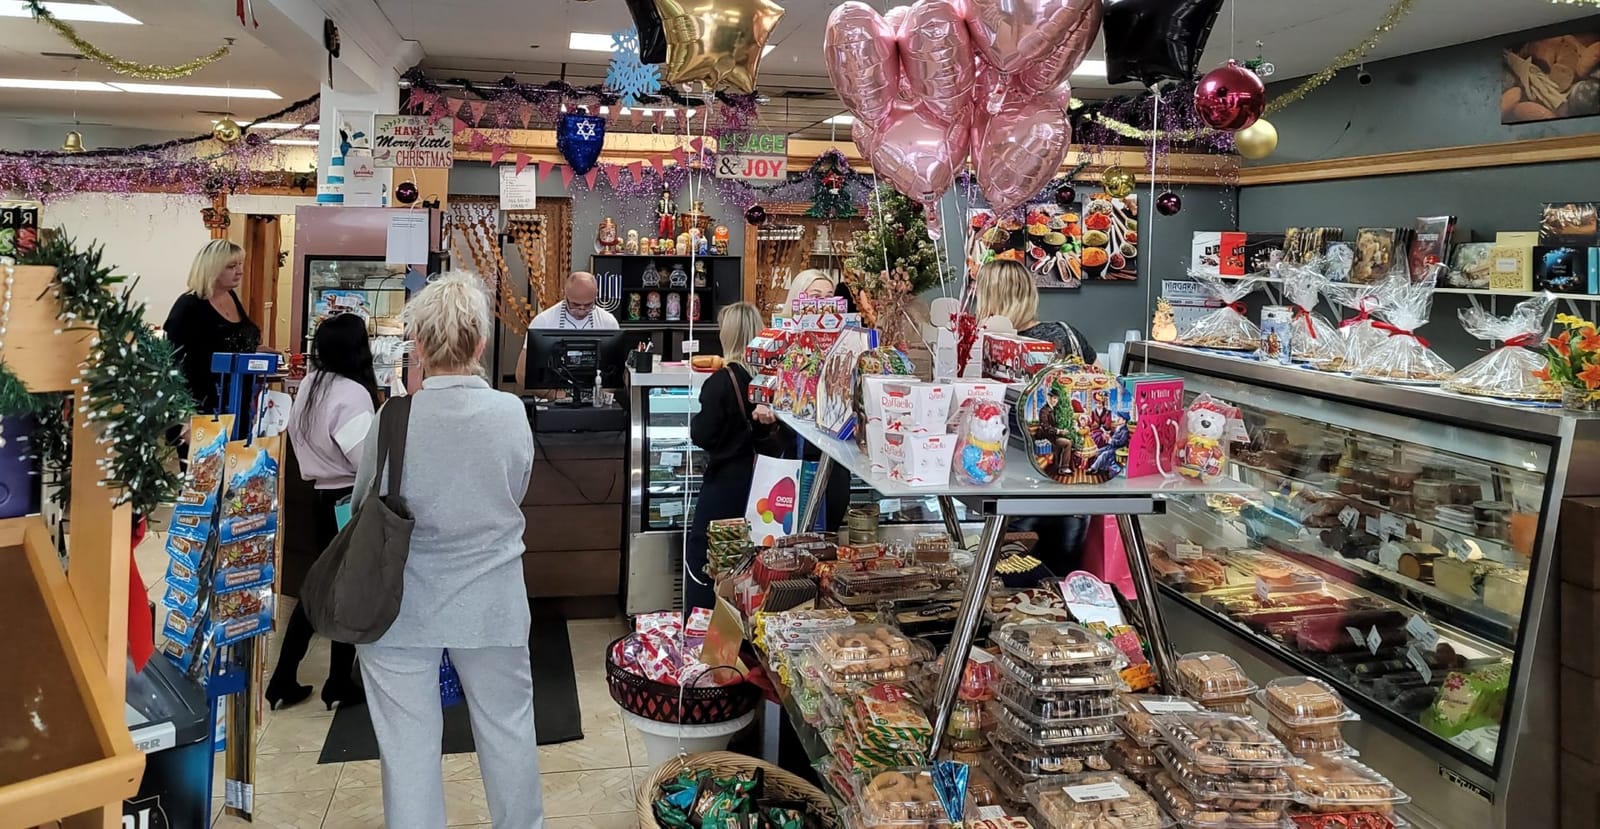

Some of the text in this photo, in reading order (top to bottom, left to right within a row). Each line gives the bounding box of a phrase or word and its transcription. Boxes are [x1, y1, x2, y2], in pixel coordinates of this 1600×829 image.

[395, 126, 435, 136] HAVE A
[376, 135, 451, 150] Merry little
[396, 150, 452, 167] CHRISTMAS
[719, 156, 784, 178] & JOY
[882, 396, 914, 409] Raffaello
